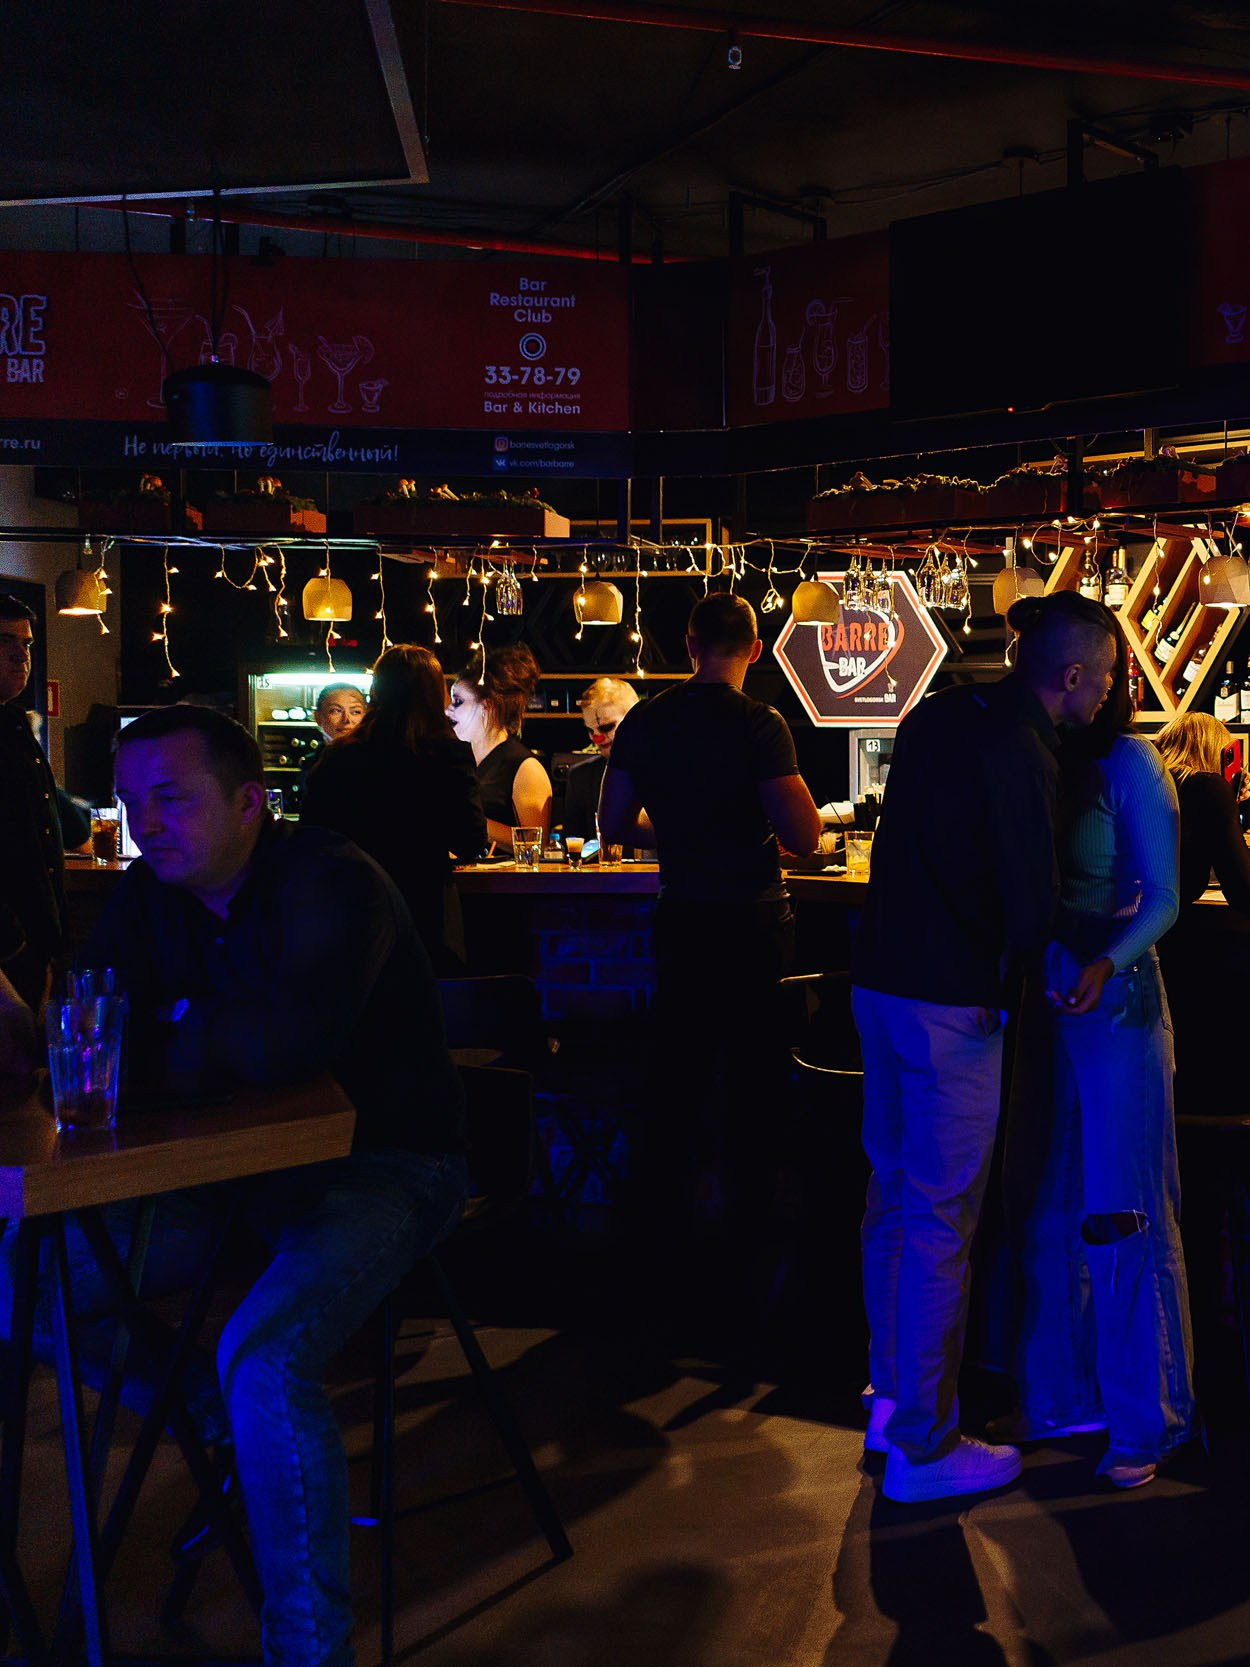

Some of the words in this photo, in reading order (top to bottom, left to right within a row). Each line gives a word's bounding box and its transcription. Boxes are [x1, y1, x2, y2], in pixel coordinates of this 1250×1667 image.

[519, 277, 547, 291] Bar
[489, 291, 576, 308] Restaurant
[513, 308, 552, 323] Club
[6, 358, 46, 383] BAR
[484, 365, 581, 386] 33-78-79
[483, 400, 508, 413] Bar
[513, 401, 523, 413] &
[528, 401, 581, 415] Kitchen
[123, 434, 147, 457] Не
[259, 430, 399, 467] единственный!
[821, 622, 889, 652] BARRE
[838, 656, 867, 677] BAR
[868, 740, 880, 752] 13
